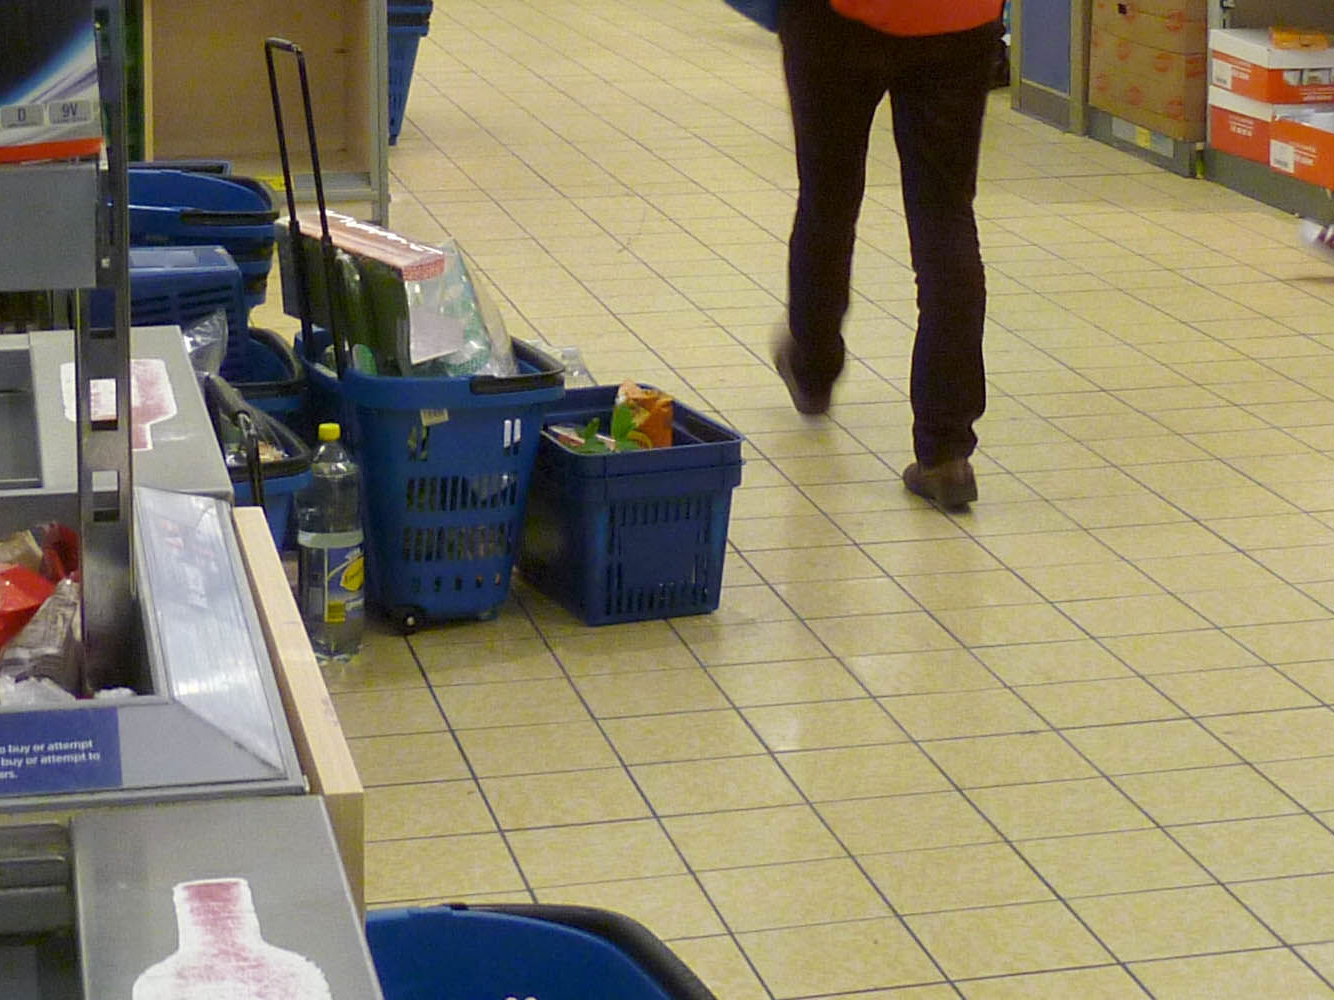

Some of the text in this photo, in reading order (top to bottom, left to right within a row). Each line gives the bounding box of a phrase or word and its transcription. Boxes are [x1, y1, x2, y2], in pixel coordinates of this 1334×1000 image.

[17, 108, 27, 122] D
[61, 103, 79, 118] 9V
[8, 743, 31, 755] buy
[33, 743, 45, 752] or
[48, 740, 93, 752] attempt
[1, 756, 23, 768] buy
[25, 756, 38, 765] or
[40, 753, 86, 765] attempt
[88, 751, 101, 761] to
